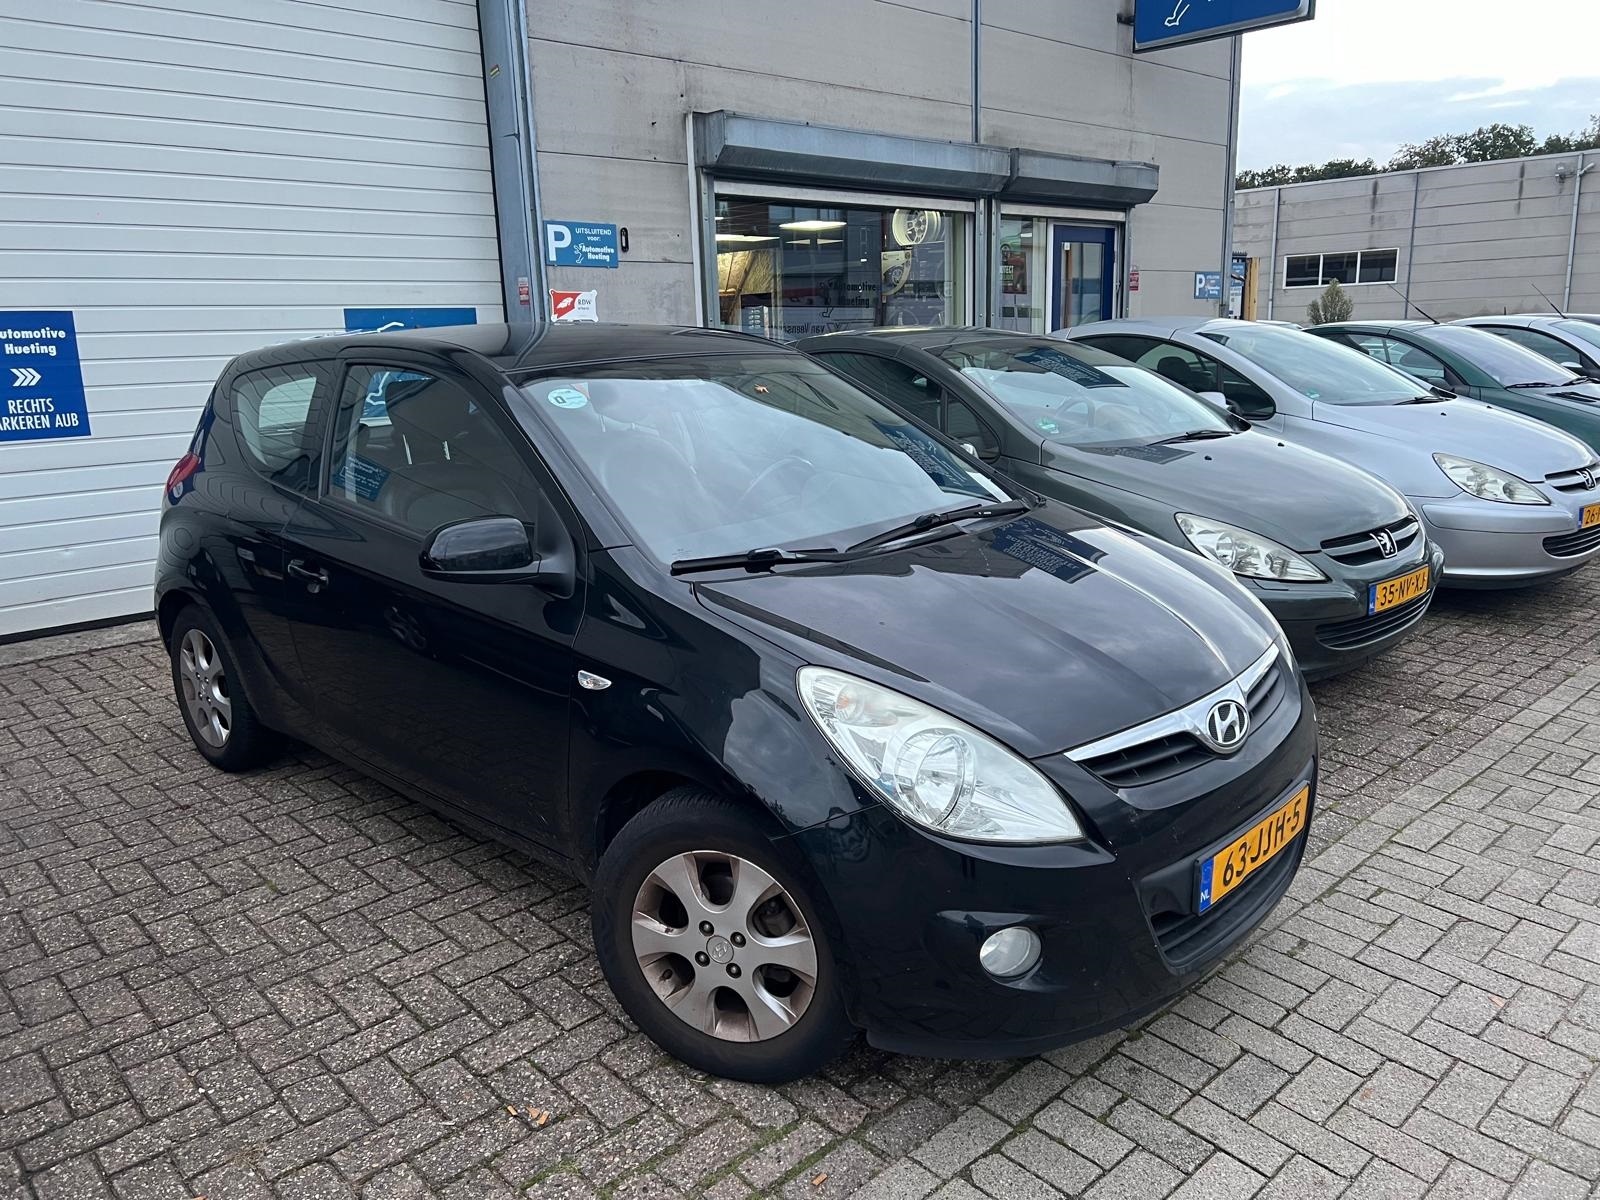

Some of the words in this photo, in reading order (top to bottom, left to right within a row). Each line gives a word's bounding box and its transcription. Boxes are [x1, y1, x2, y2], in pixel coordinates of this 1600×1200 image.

[575, 227, 612, 236] UITSLUITEND
[547, 224, 572, 262] P
[582, 245, 615, 254] Automotive
[587, 252, 610, 262] Hueting
[1195, 273, 1206, 297] P
[4, 342, 57, 356] Hueting
[7, 398, 55, 414] RECHTS
[55, 412, 79, 428] AUB
[1222, 797, 1302, 887] 63-JJH-5
